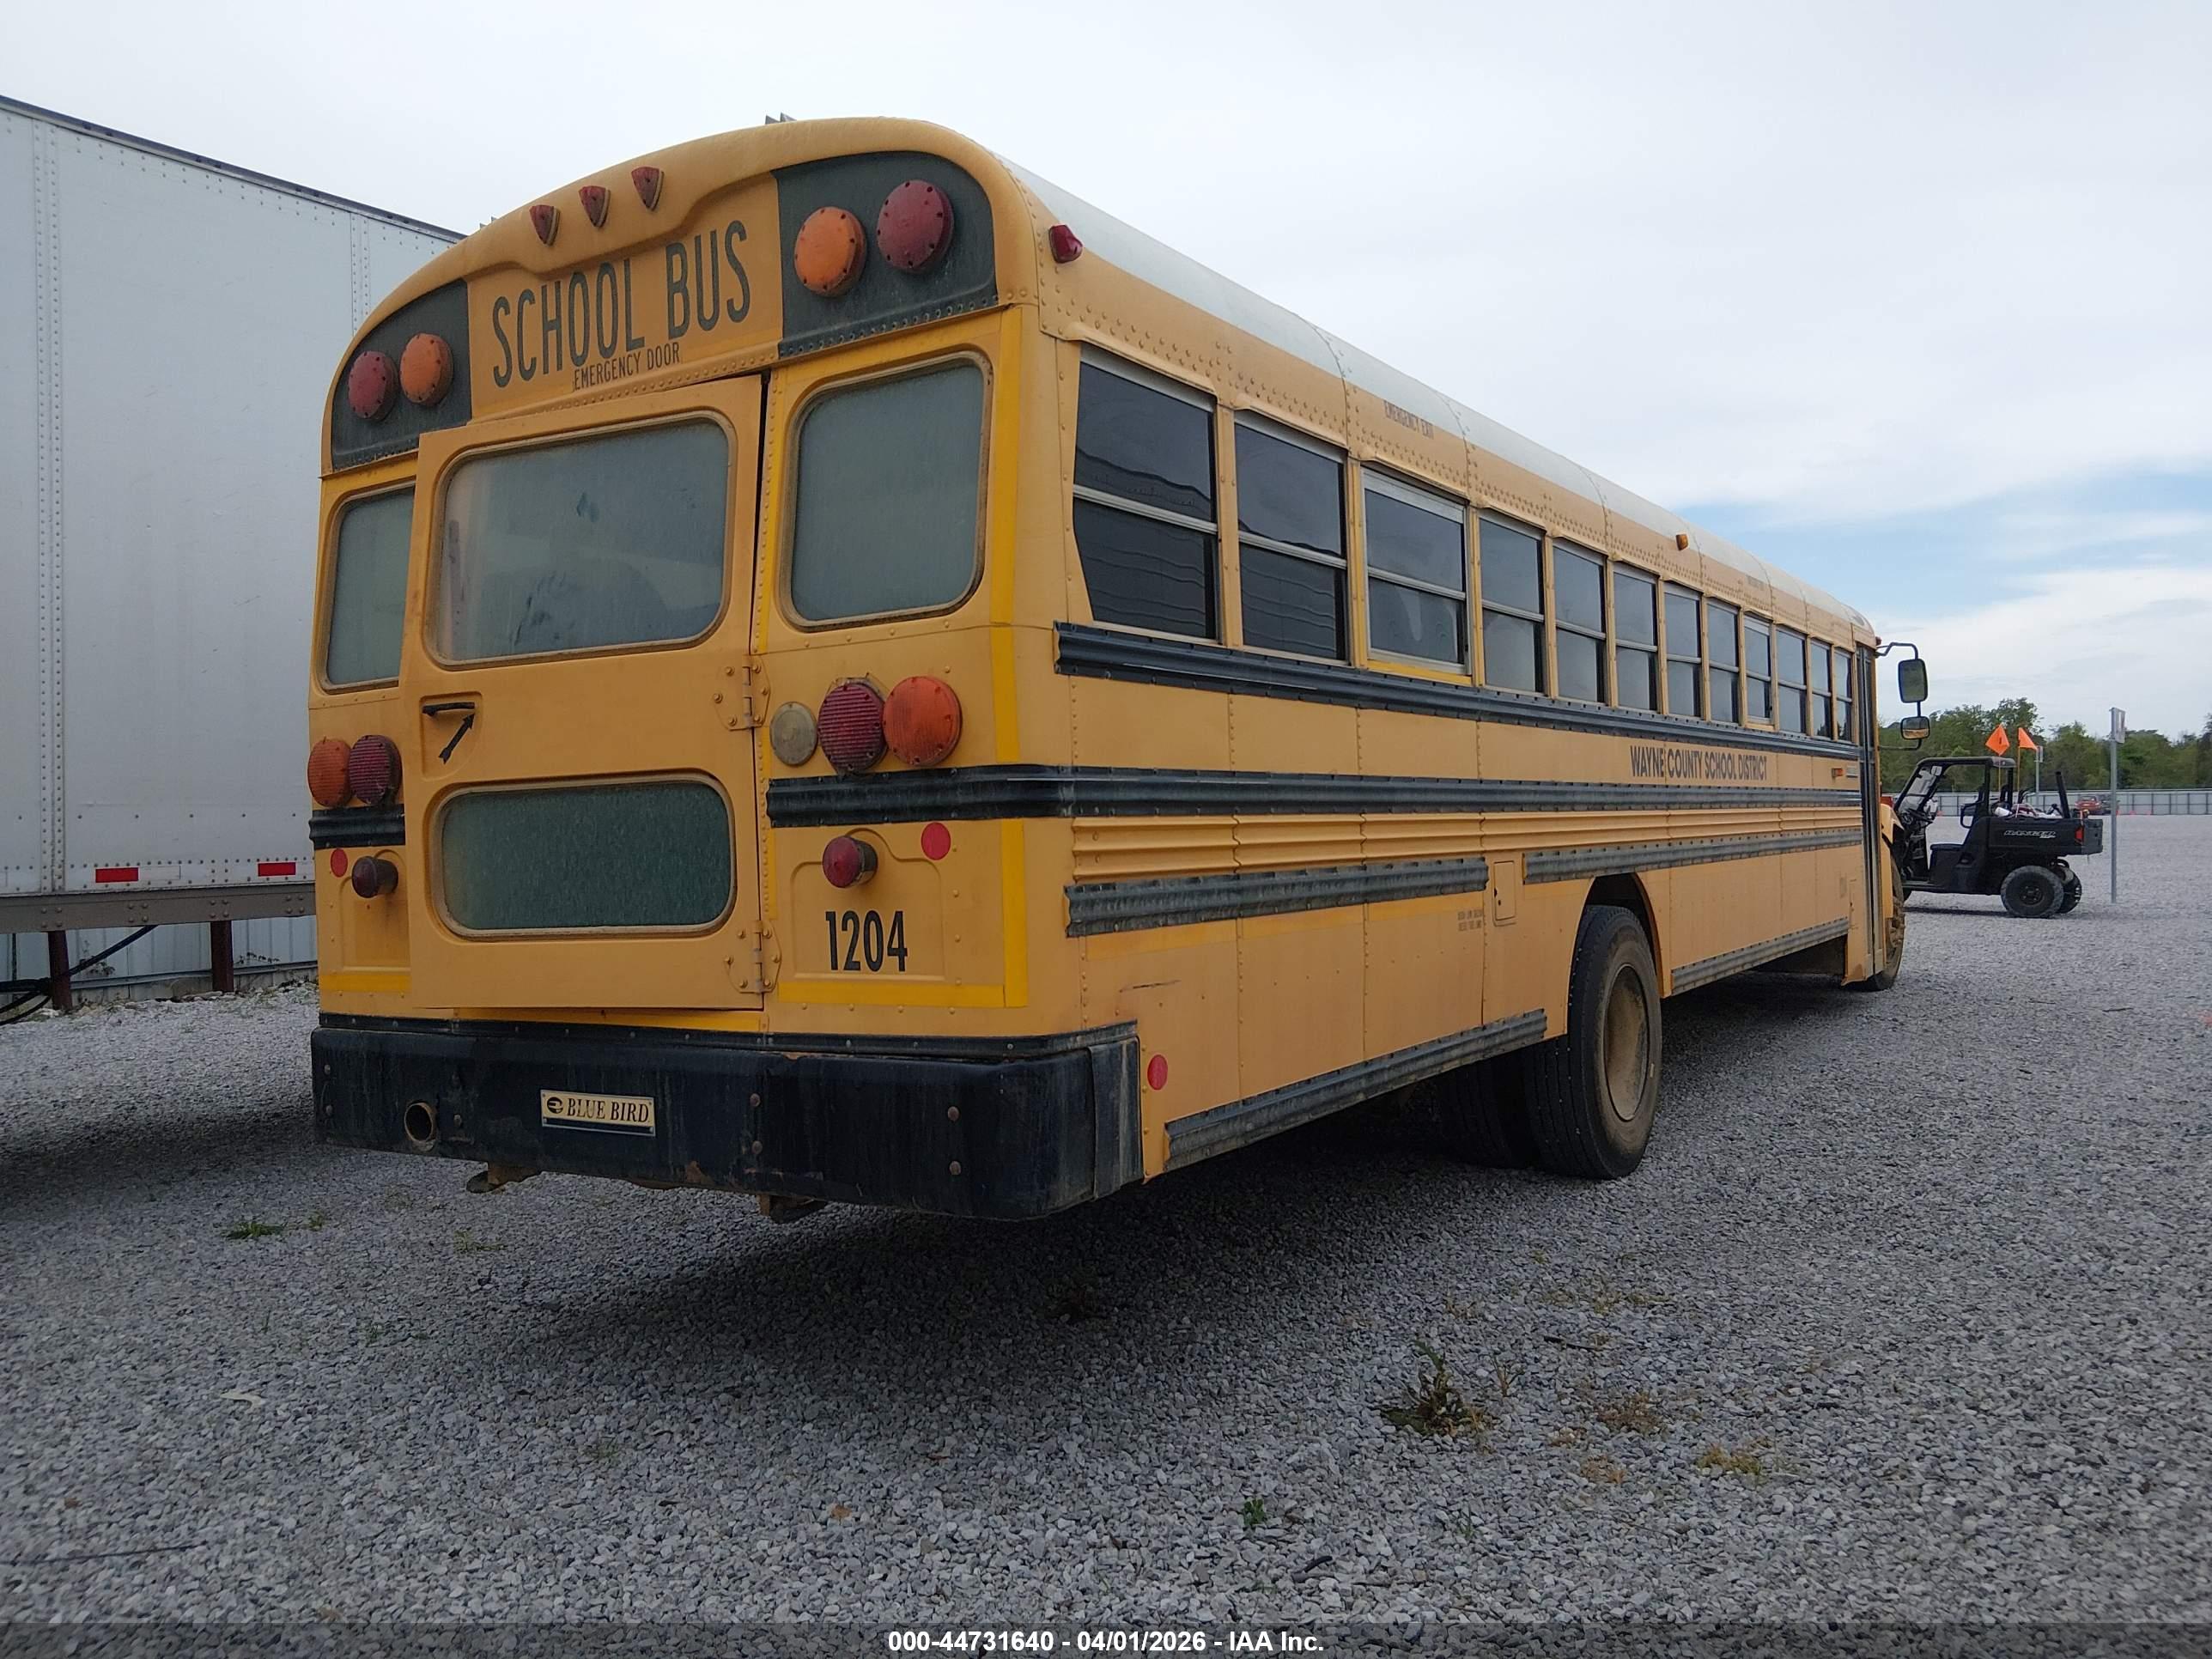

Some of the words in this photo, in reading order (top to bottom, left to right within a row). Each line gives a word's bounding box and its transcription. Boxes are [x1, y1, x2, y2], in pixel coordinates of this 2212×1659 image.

[492, 258, 646, 388] SCHOOL
[665, 220, 750, 340] BUS
[574, 350, 641, 391] EMERGENCY
[647, 342, 680, 371] DOOR
[1630, 745, 1665, 777] WAYNE
[1667, 749, 1703, 779] COUNTY
[1705, 751, 1736, 780] SCHOOL
[1738, 754, 1767, 781] DISTRICT
[824, 909, 908, 973] 1204
[567, 1097, 606, 1120] BLUE
[611, 1102, 649, 1123] BIRD
